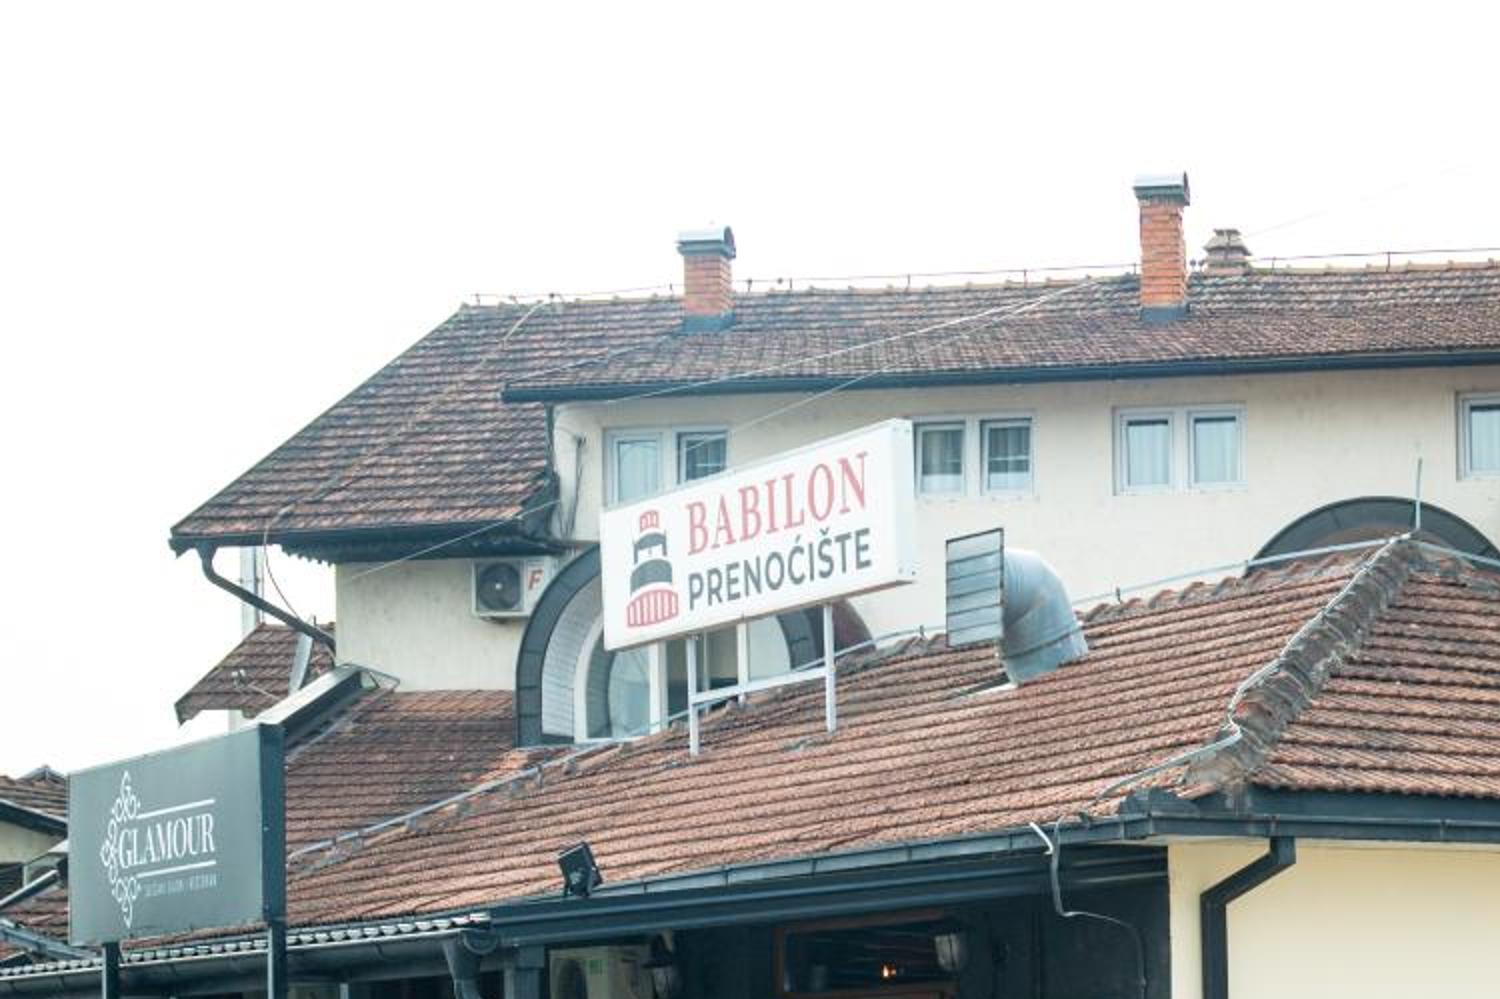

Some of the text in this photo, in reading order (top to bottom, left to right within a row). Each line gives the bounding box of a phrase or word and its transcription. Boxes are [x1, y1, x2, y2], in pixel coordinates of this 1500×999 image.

[685, 452, 868, 555] BABILON
[688, 526, 872, 610] PRENOĆIŠTE
[118, 812, 215, 869] GLAMOUR
